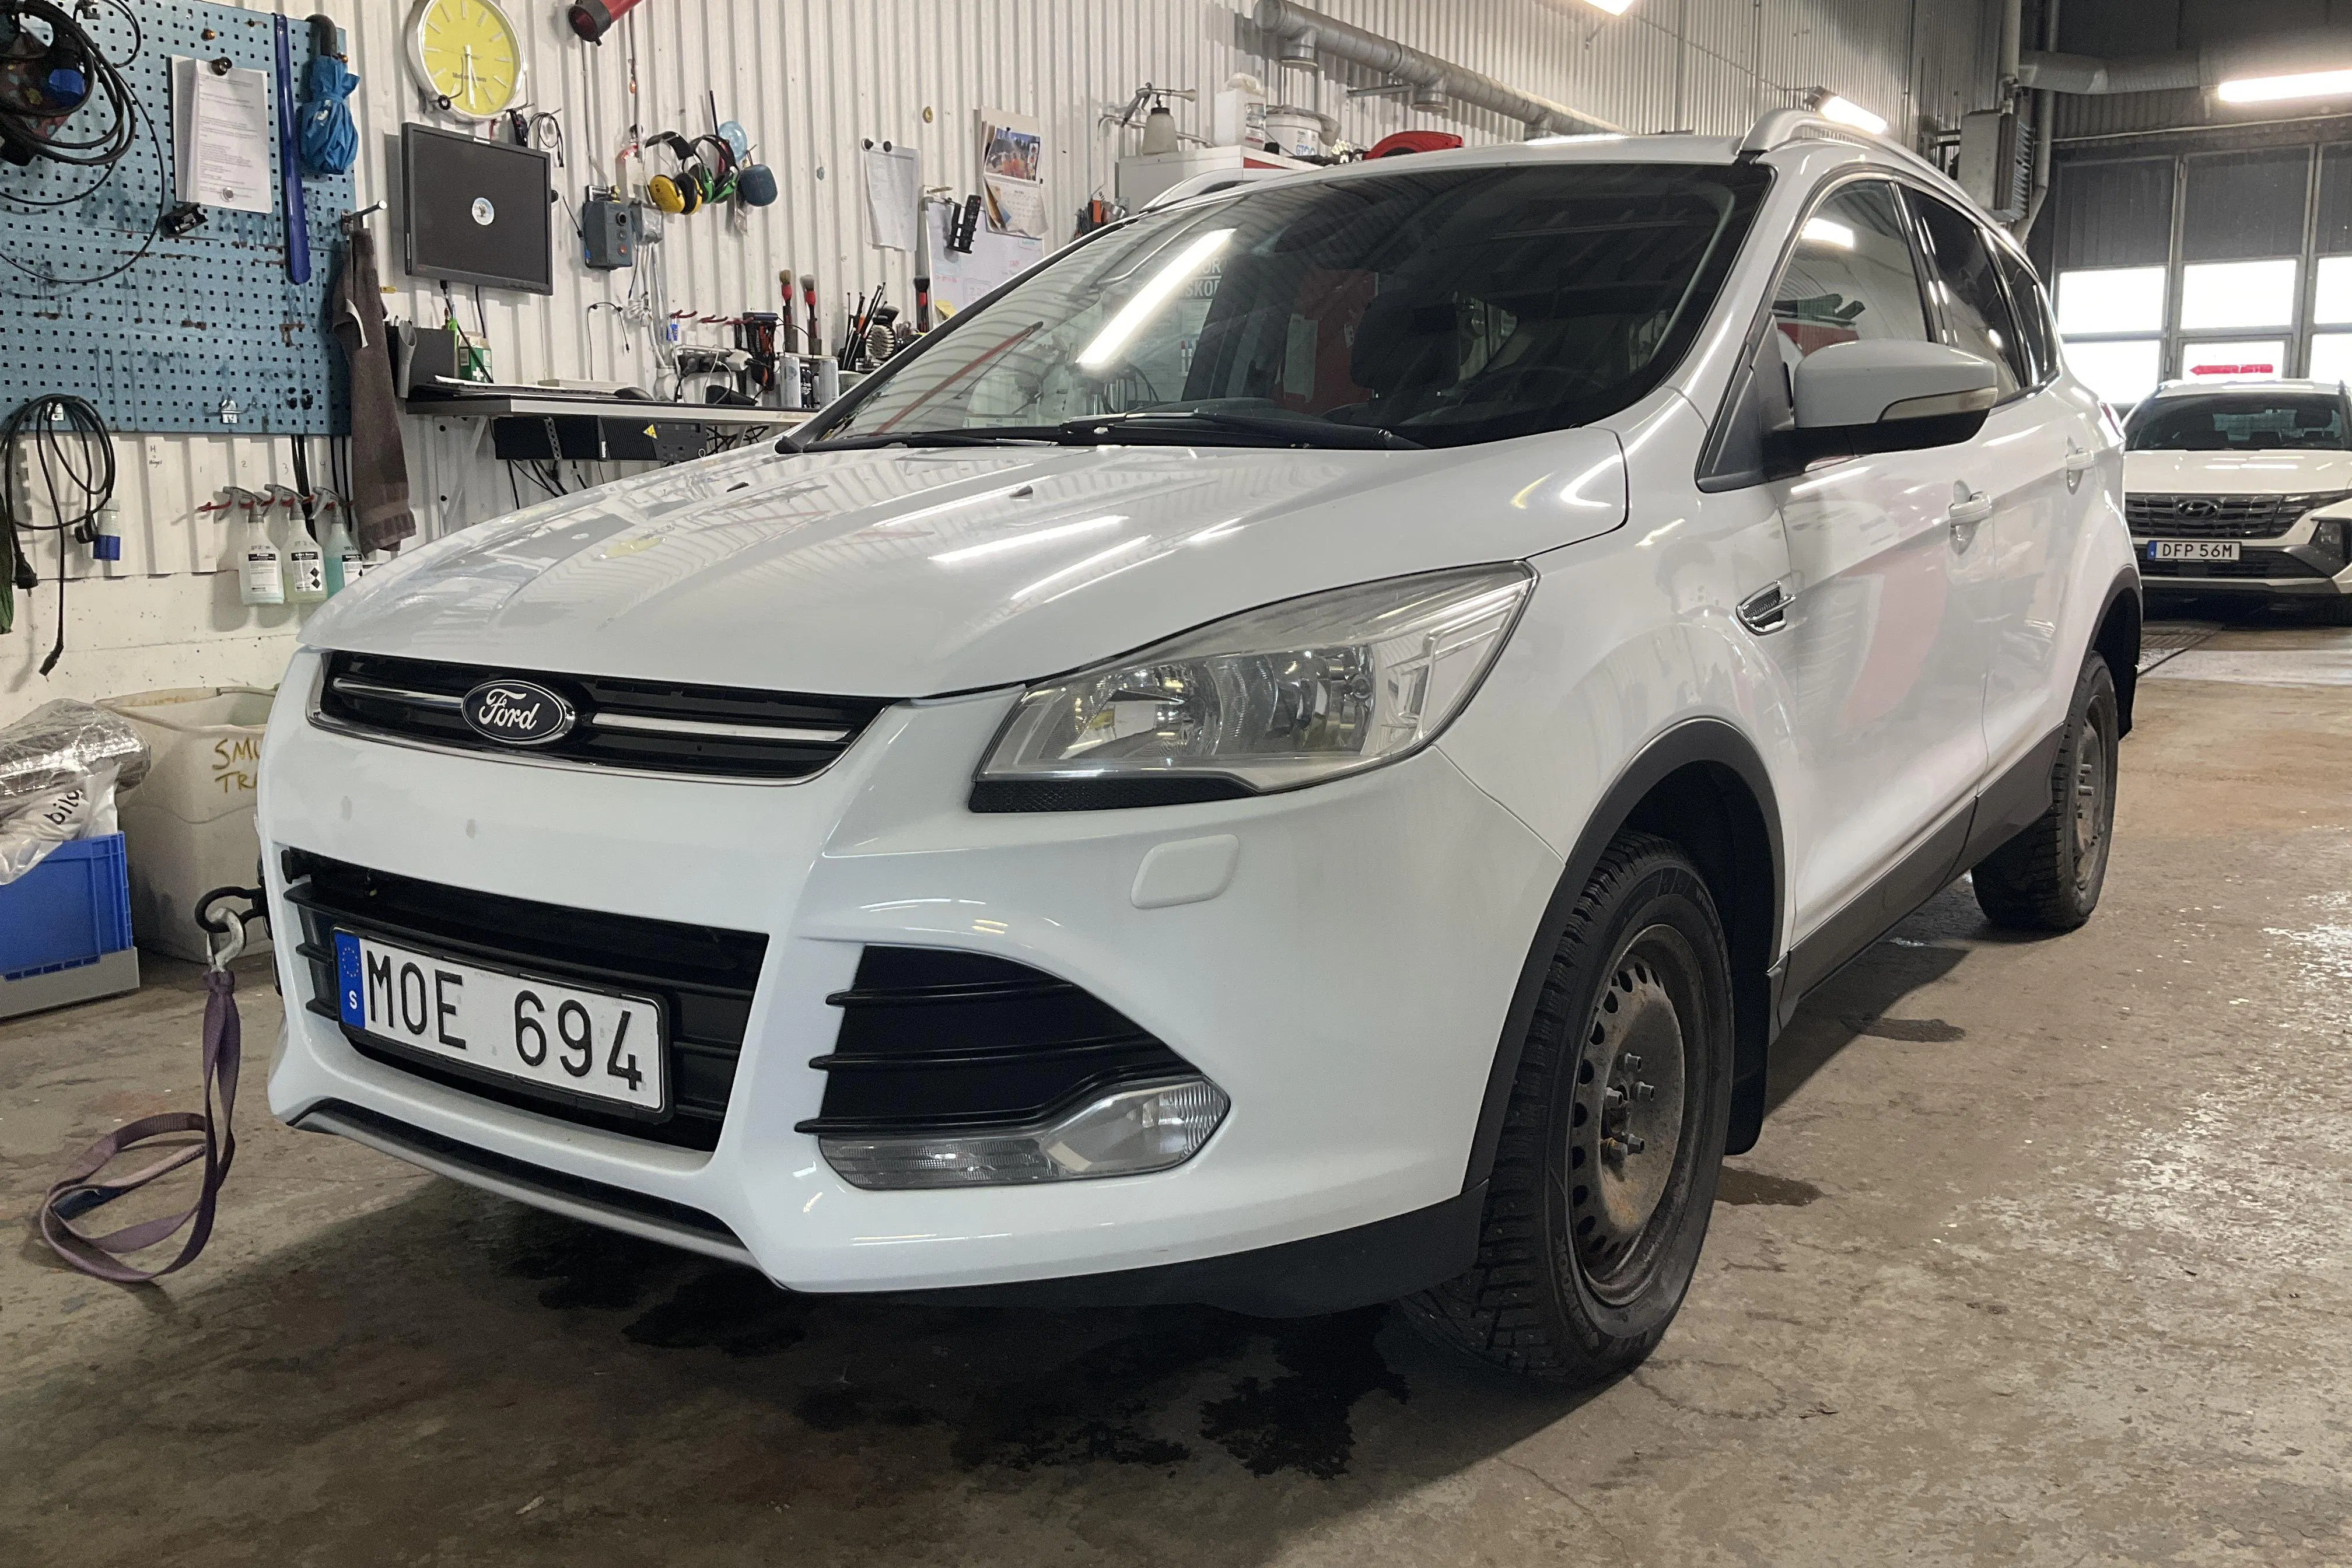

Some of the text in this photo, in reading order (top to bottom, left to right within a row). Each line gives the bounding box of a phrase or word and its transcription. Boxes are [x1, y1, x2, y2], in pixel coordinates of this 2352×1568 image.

[282, 463, 289, 475] 3
[319, 460, 326, 473] 4
[2162, 543, 2233, 558] DFP 56M
[478, 688, 541, 730] Ford
[349, 990, 358, 1010] S
[366, 950, 642, 1091] MOE 694
